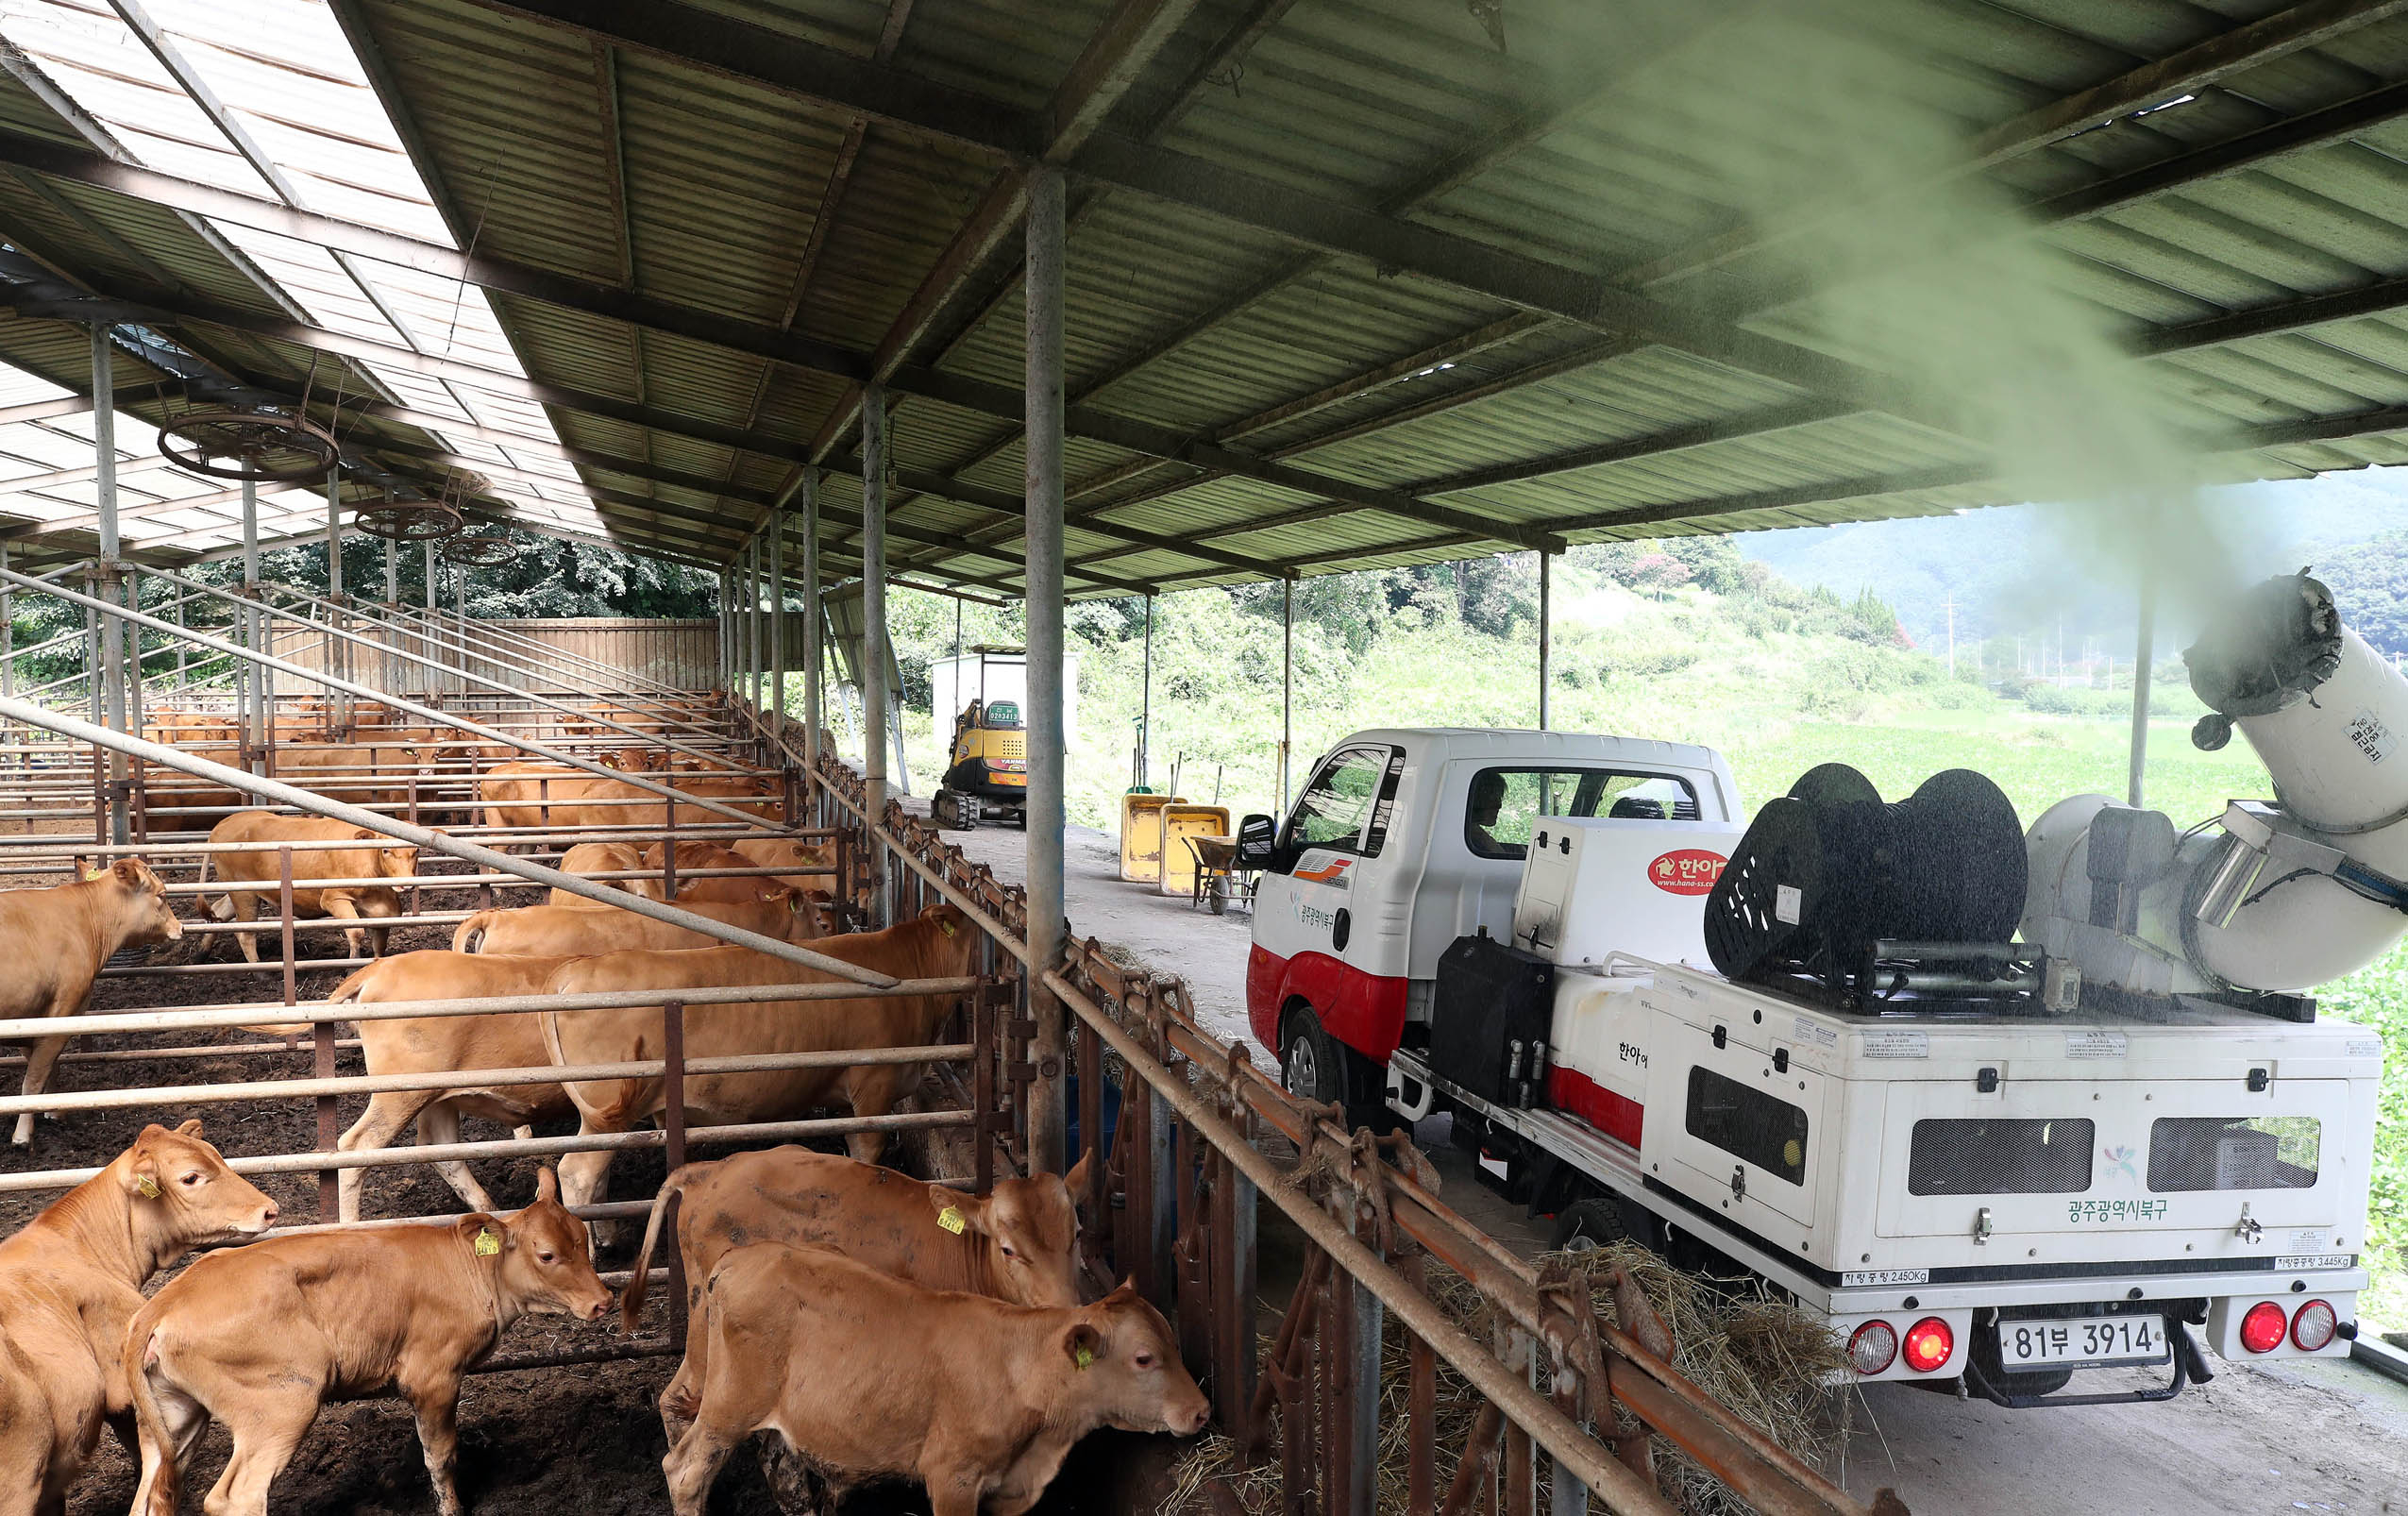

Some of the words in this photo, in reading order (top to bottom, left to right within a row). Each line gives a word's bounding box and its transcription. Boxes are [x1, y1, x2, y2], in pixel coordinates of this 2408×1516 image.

[2357, 717, 2381, 743] 운전중
[2350, 730, 2382, 762] 접근금지
[1301, 904, 1334, 932] 광주광역시북구
[2068, 1199, 2167, 1223] 광주광역시북구
[1891, 1271, 1927, 1283] 2,450Kg
[2015, 1326, 2068, 1358] 81부
[2082, 1322, 2152, 1355] 3914
